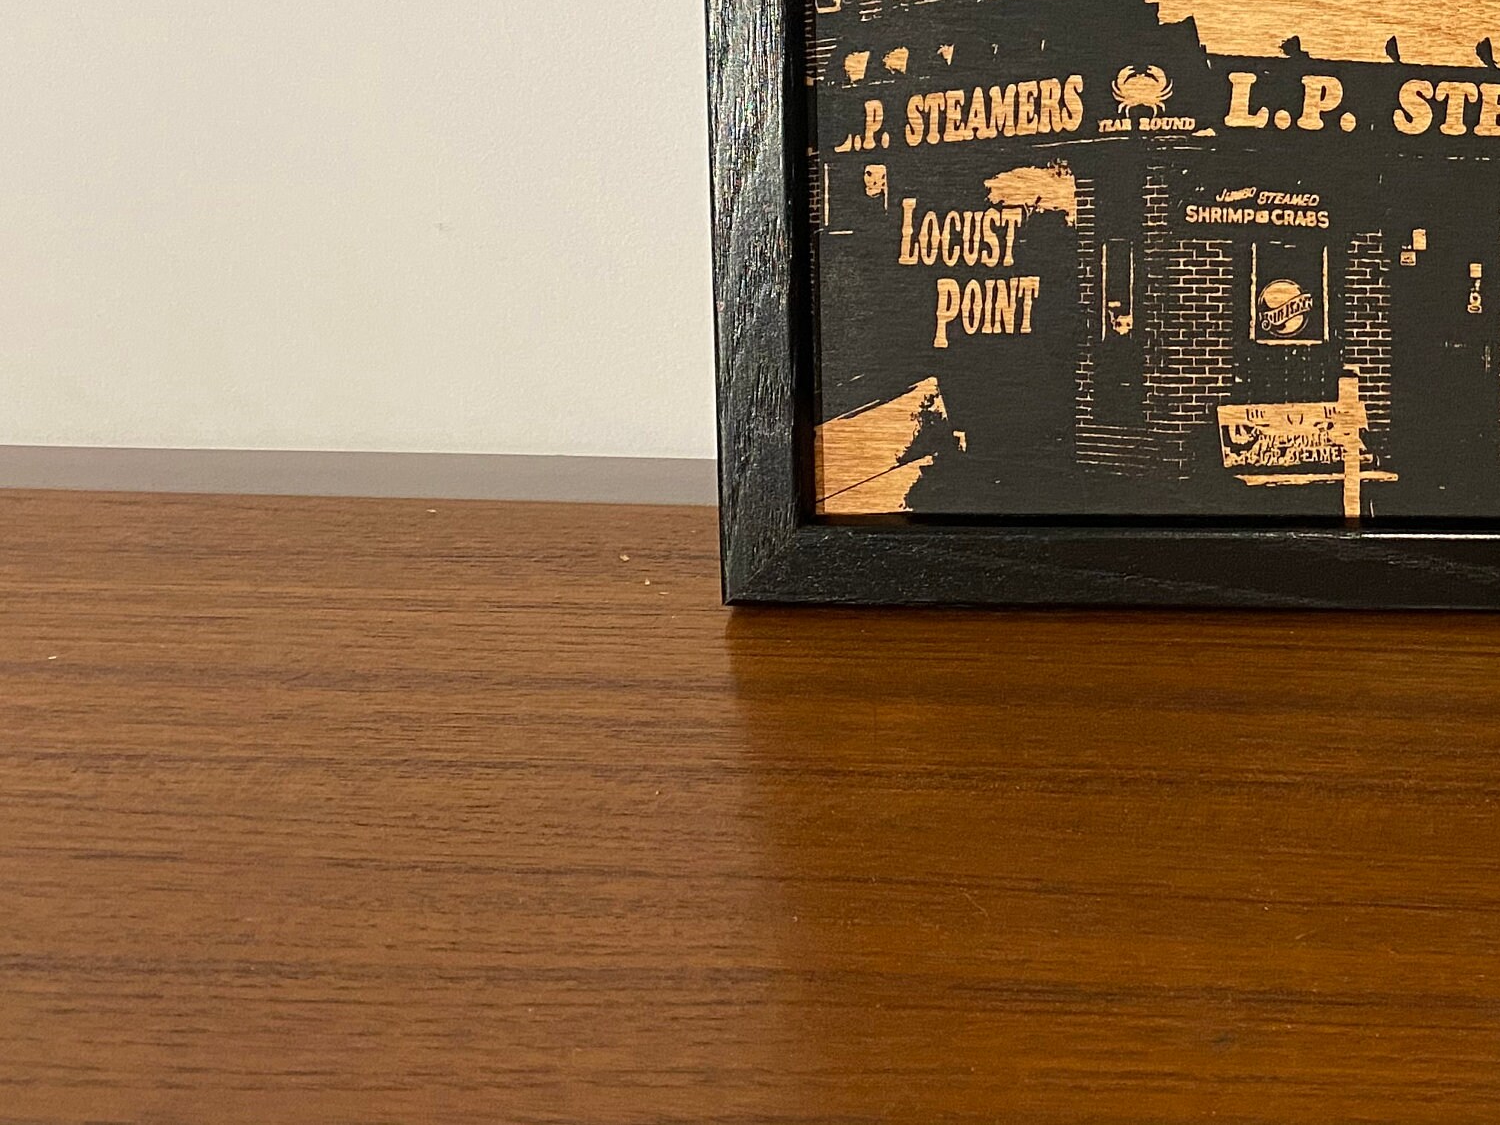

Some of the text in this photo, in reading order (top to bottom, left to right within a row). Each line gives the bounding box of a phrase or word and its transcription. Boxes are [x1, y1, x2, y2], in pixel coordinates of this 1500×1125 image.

[905, 74, 1084, 147] STEAMERS
[1224, 72, 1356, 132] L.P.
[898, 198, 1023, 267] LOCUST
[1185, 204, 1255, 224] SHRIMP
[1270, 209, 1330, 229] CRABS
[933, 277, 1039, 348] POINT
